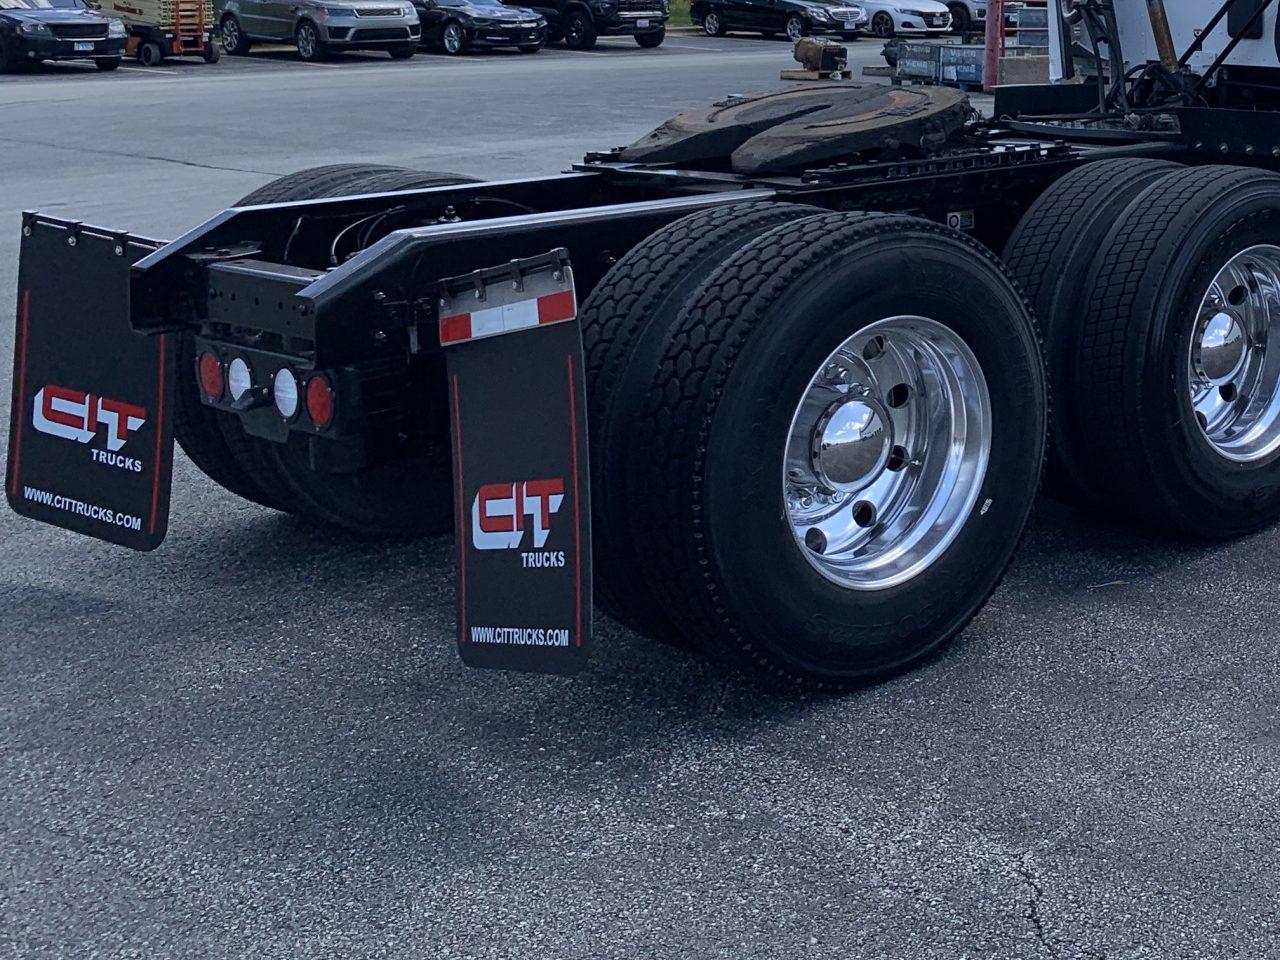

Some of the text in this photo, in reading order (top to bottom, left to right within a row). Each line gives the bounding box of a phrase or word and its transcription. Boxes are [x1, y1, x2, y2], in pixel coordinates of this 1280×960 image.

[33, 384, 146, 452] CIT
[91, 448, 142, 472] TRUCKS
[24, 486, 142, 531] WWW.CITTRUCKS.COM
[472, 478, 564, 550] CIT
[521, 551, 566, 568] TRUCKS
[471, 626, 569, 646] WWW.CITTRUCKS.COM
